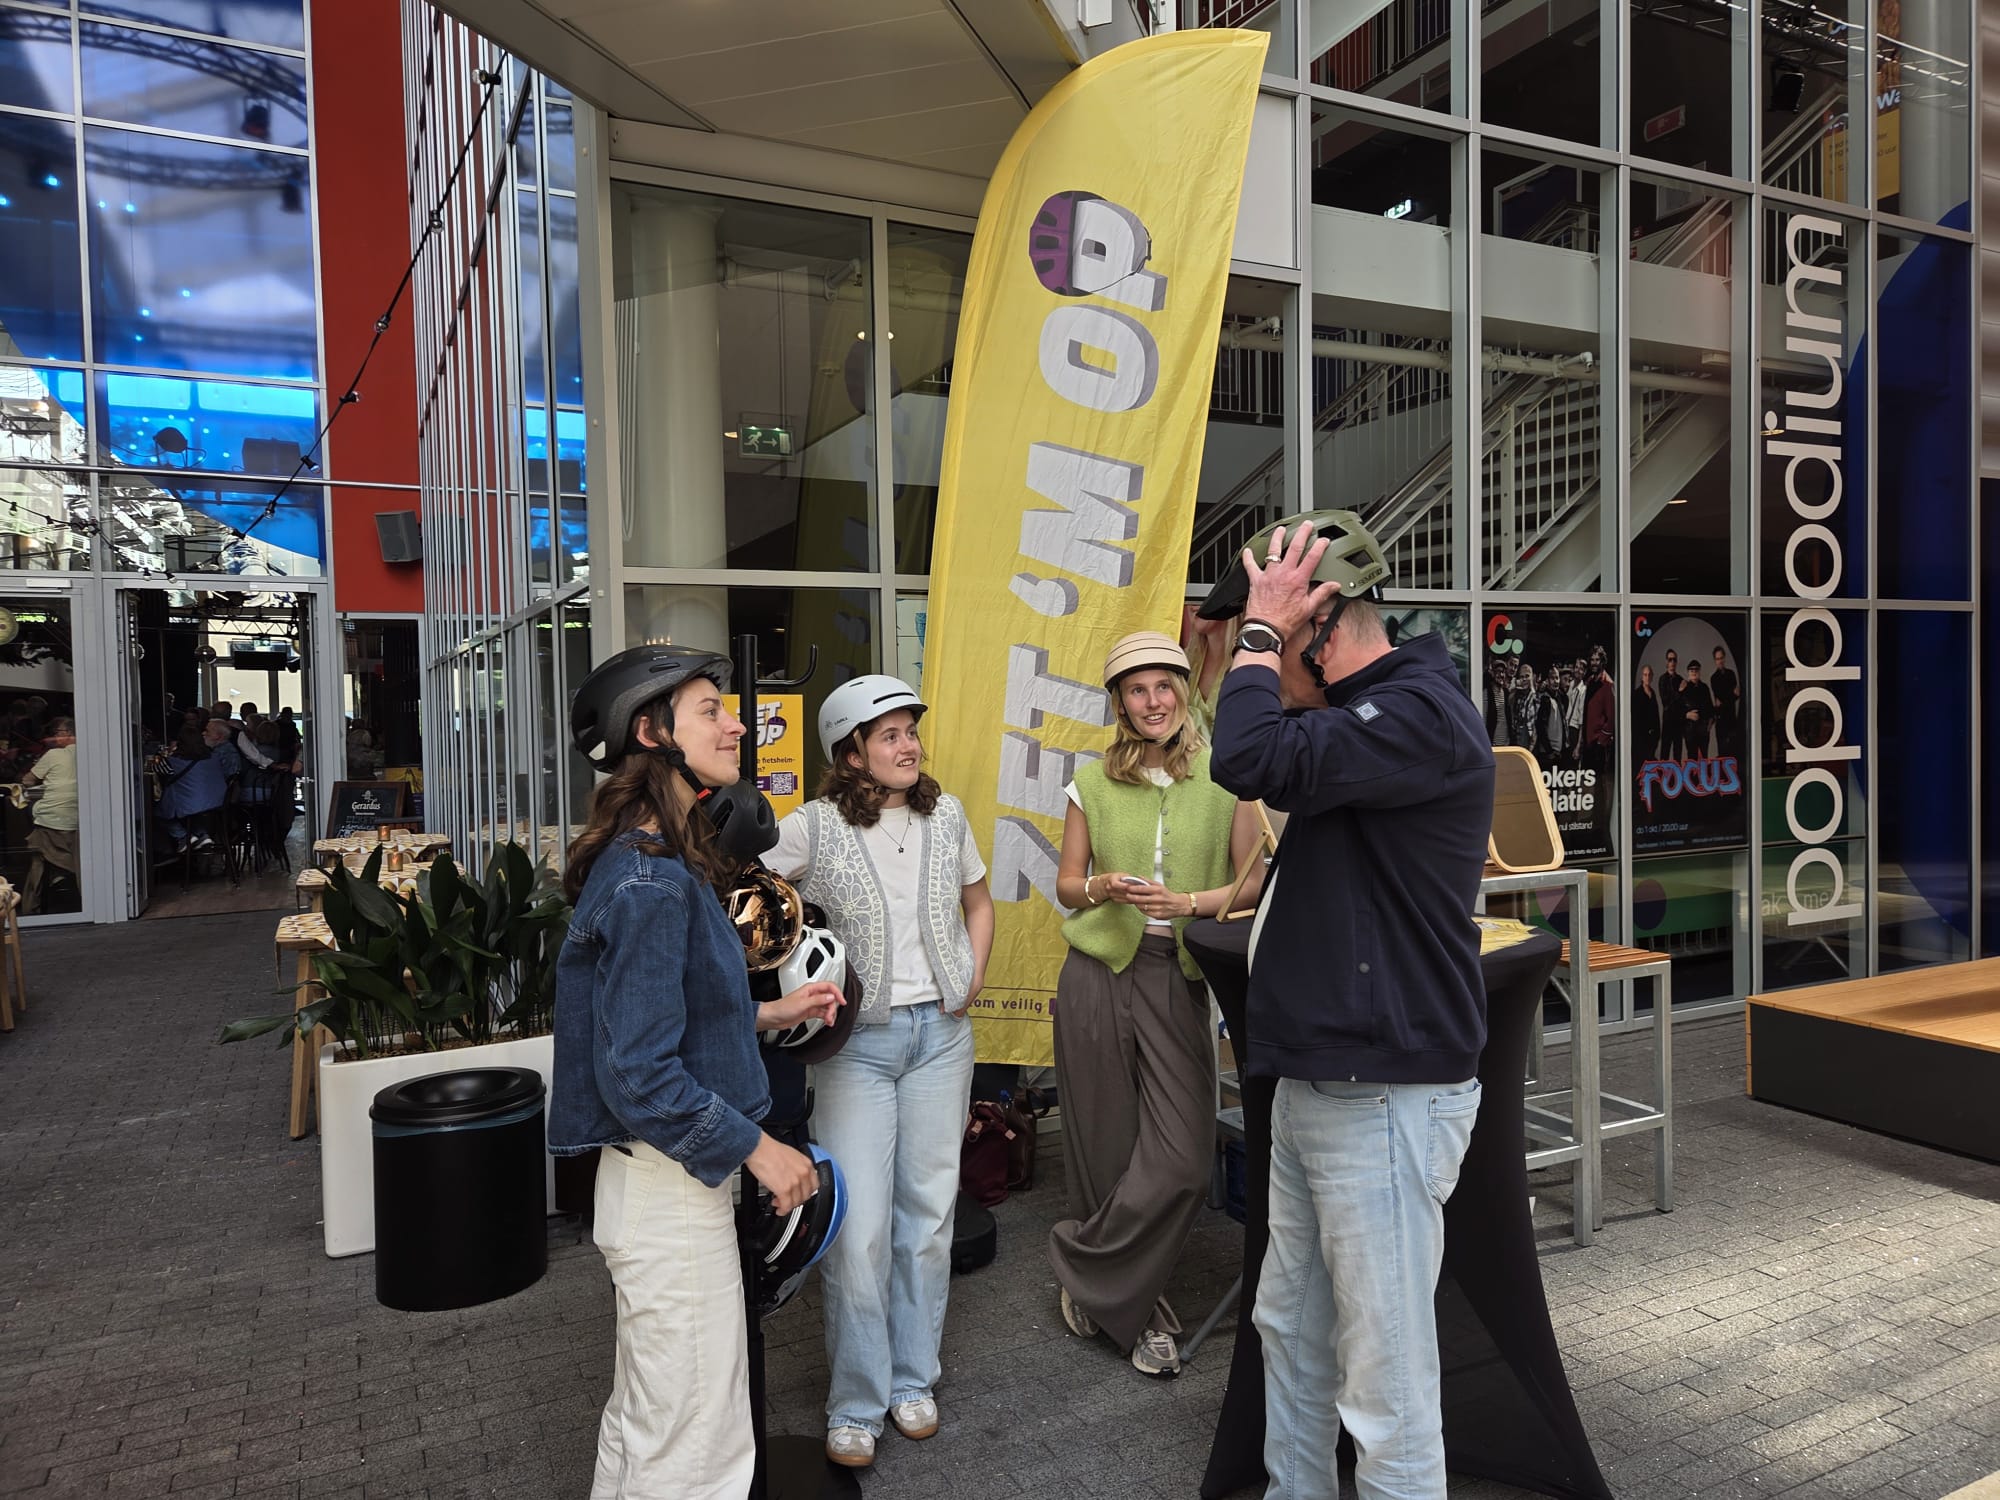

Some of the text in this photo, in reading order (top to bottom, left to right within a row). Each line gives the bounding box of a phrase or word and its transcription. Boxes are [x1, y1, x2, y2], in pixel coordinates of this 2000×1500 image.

[1038, 198, 1168, 413] OP
[1764, 213, 1863, 927] poppodium
[1550, 788, 1594, 812] latie
[1636, 750, 1742, 813] FOCUS
[351, 798, 381, 812] Gerardus
[969, 998, 1042, 1014] om veilig
